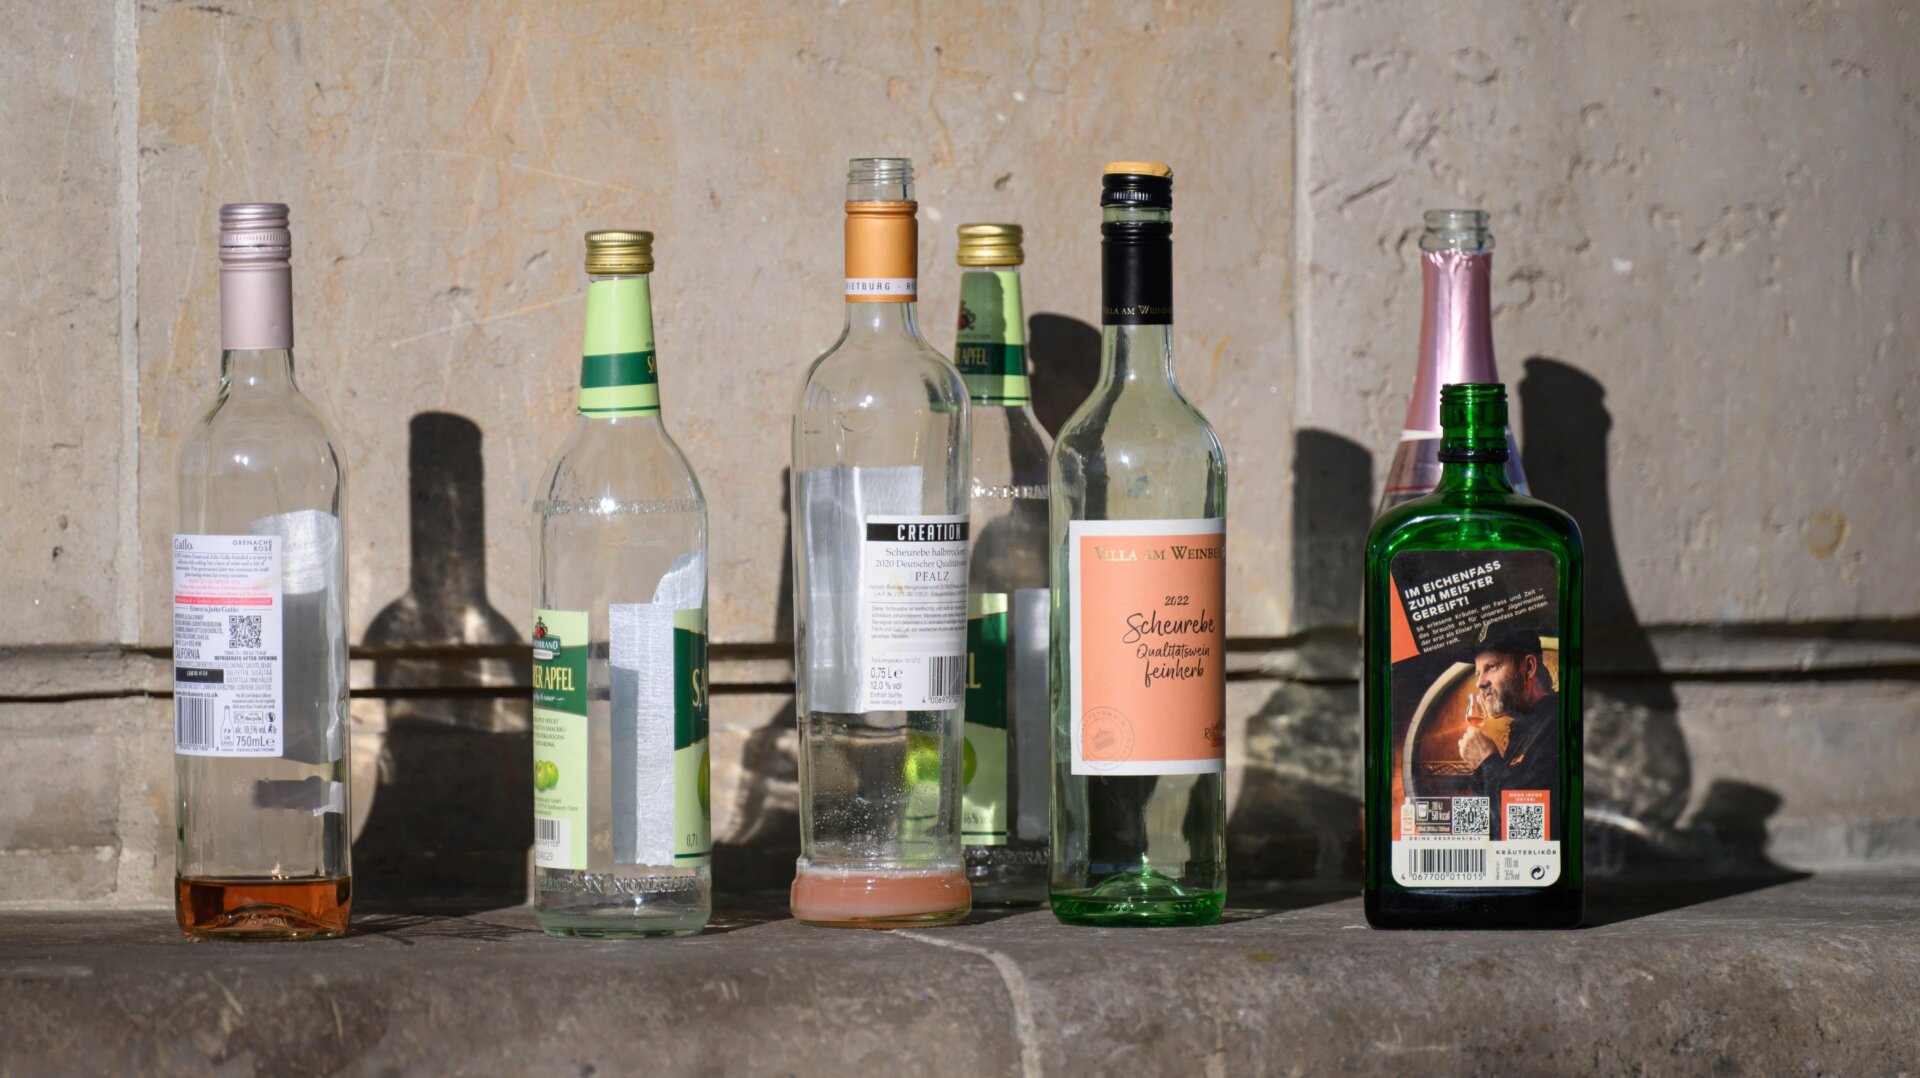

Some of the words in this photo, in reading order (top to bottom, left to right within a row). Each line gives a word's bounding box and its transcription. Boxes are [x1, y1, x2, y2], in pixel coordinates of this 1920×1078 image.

[897, 524, 960, 541] CREATION
[886, 548, 930, 557] Scheurebe
[1094, 547, 1138, 561] VILLA
[1144, 549, 1166, 560] AM
[897, 559, 934, 568] Deutscher
[916, 571, 949, 581] PFALZ
[1404, 585, 1420, 599] IM
[1423, 560, 1502, 593] EICHENFASS
[1164, 596, 1189, 606] 2022
[1408, 594, 1436, 611] ZUM
[1439, 575, 1494, 603] MEISTER
[1412, 596, 1470, 622] GEREIFT!
[1427, 617, 1452, 629] erlesene
[1493, 599, 1507, 607] Fass
[1510, 593, 1521, 602] und
[1524, 589, 1536, 598] Zeit
[1515, 608, 1527, 616] zum
[1528, 601, 1548, 612] echten
[1122, 609, 1215, 643] Scheurebe
[1419, 632, 1430, 640] das
[1432, 623, 1455, 635] braucht
[1480, 608, 1504, 619] unseren
[1136, 642, 1210, 659] Qualitätswein
[1423, 642, 1445, 653] Meister
[544, 666, 575, 691] APFEL
[870, 667, 885, 679] 0,75
[1145, 658, 1204, 688] feinherb
[893, 681, 902, 689] vol
[1439, 811, 1450, 820] kcal
